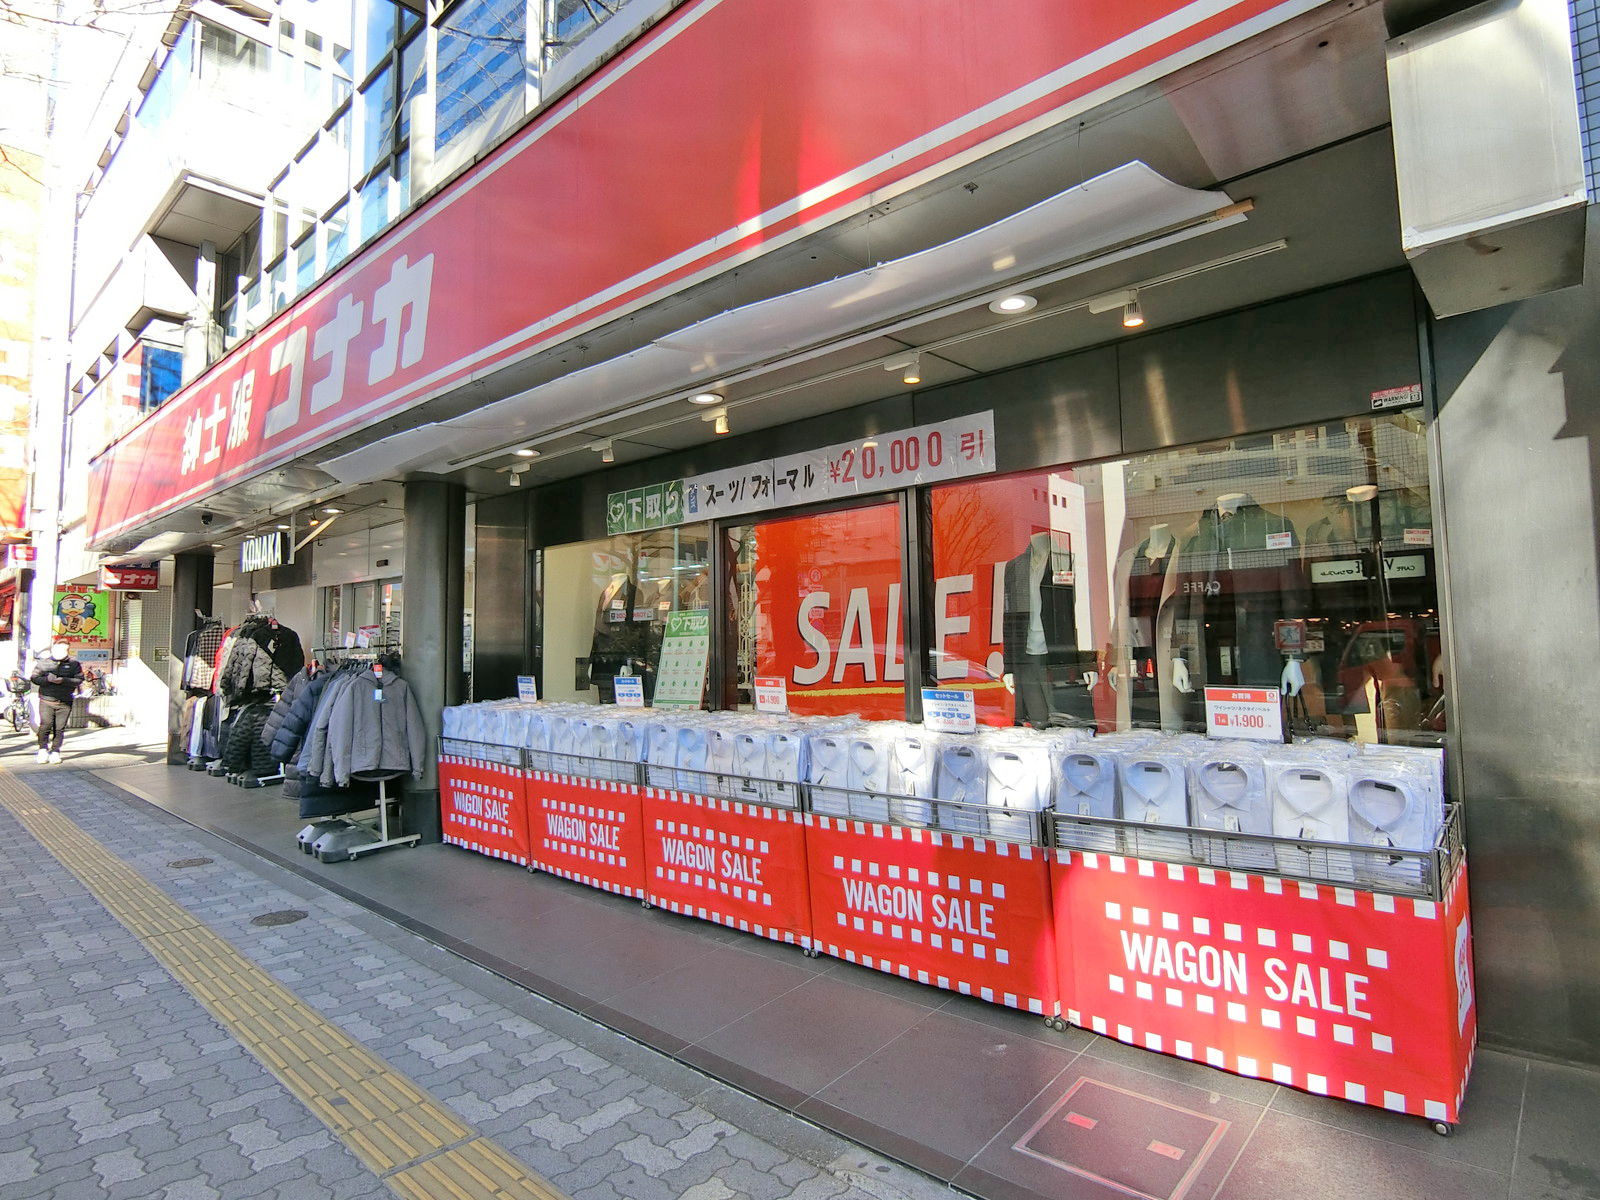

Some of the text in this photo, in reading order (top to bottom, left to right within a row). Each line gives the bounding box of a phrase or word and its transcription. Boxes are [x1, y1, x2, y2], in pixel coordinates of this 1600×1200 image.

[181, 252, 435, 475] 紳士服 コナカ
[829, 431, 943, 483] ¥20,000
[959, 429, 984, 461] 引
[626, 489, 679, 521] 下取り
[242, 531, 282, 573] KONAKA
[1230, 714, 1264, 729] ¥1,900
[454, 791, 509, 825] WAGON SALE
[547, 813, 620, 851] WAGON SALE
[662, 837, 764, 886] WAGON SALE
[842, 877, 996, 940] WAGON SALE
[1120, 930, 1373, 1022] WAGON SALE
